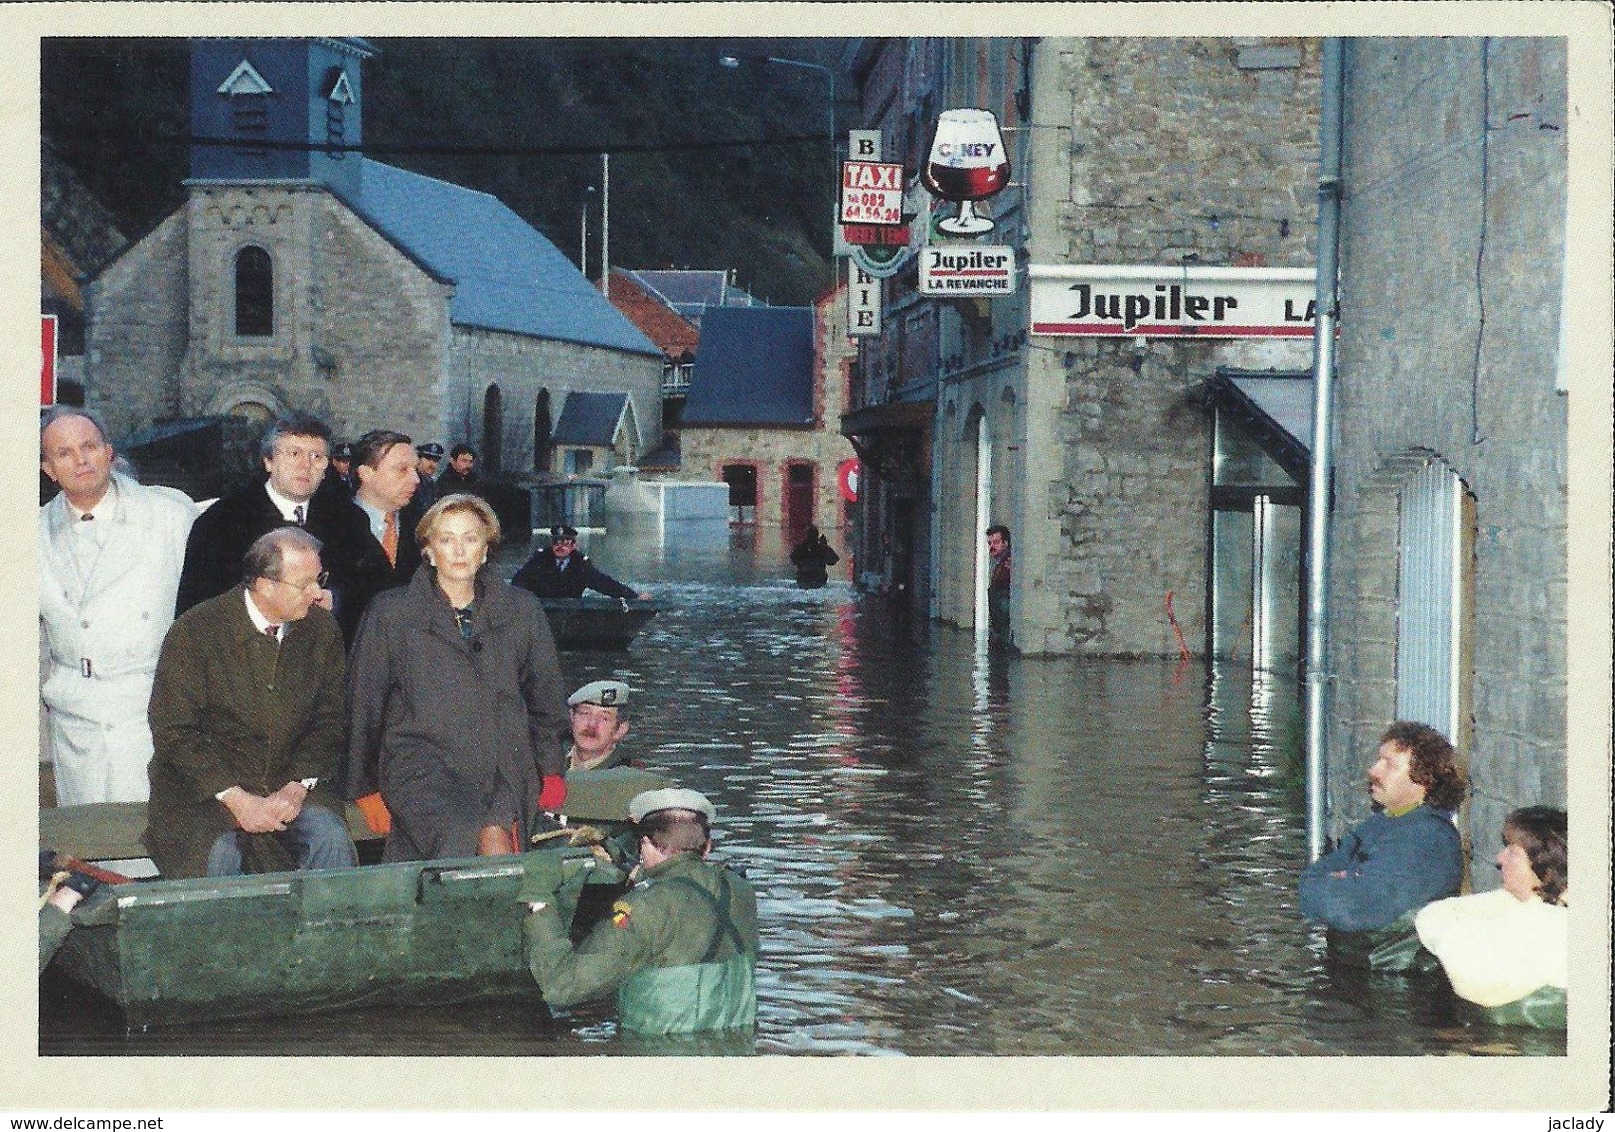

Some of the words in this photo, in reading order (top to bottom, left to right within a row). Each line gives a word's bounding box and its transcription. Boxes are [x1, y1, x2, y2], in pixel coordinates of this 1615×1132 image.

[938, 142, 996, 157] CNEY
[847, 165, 902, 189] TAXI
[861, 193, 885, 208] 082
[930, 250, 1008, 272] Jupiler
[928, 279, 944, 290] LA
[946, 279, 1009, 290] REVANCHE
[1068, 284, 1239, 330] Jupiler
